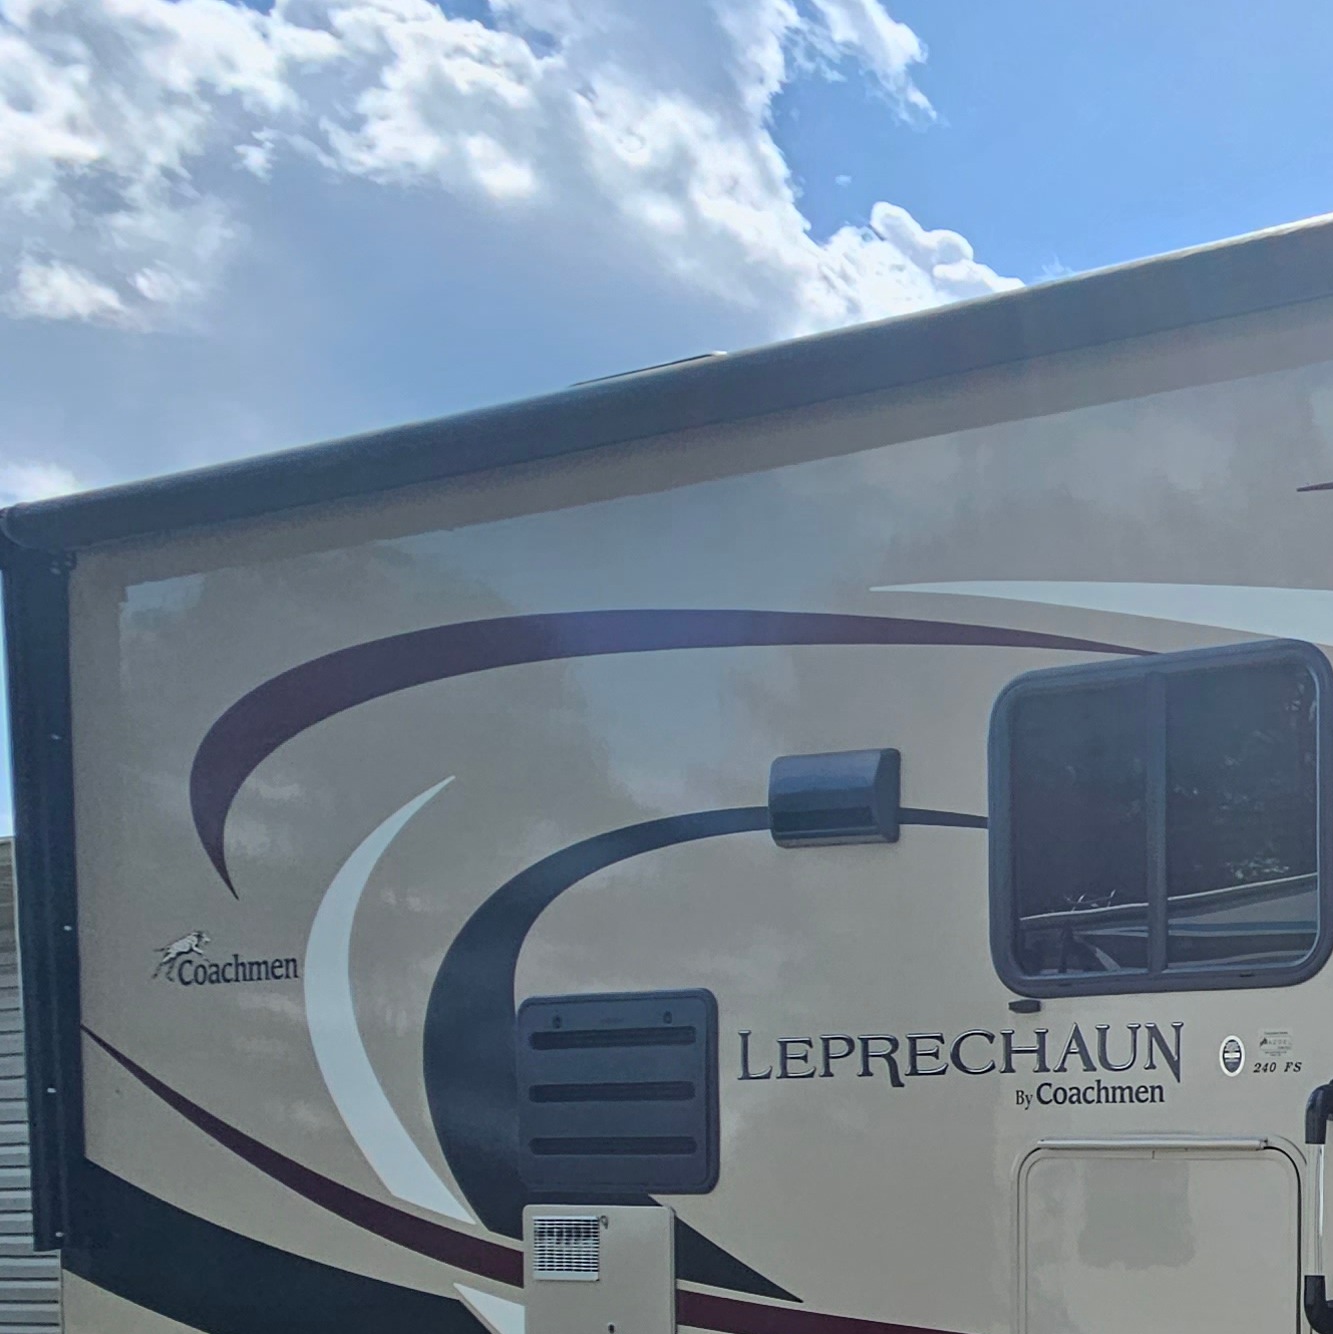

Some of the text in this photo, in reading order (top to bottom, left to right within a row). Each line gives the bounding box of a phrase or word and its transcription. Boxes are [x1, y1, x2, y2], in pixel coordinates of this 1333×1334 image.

[177, 953, 299, 986] Coachmen
[737, 1021, 1184, 1088] LEPRECHAUN
[1253, 1061, 1303, 1073] 240 FS
[1015, 1078, 1165, 1111] By Coachmen
